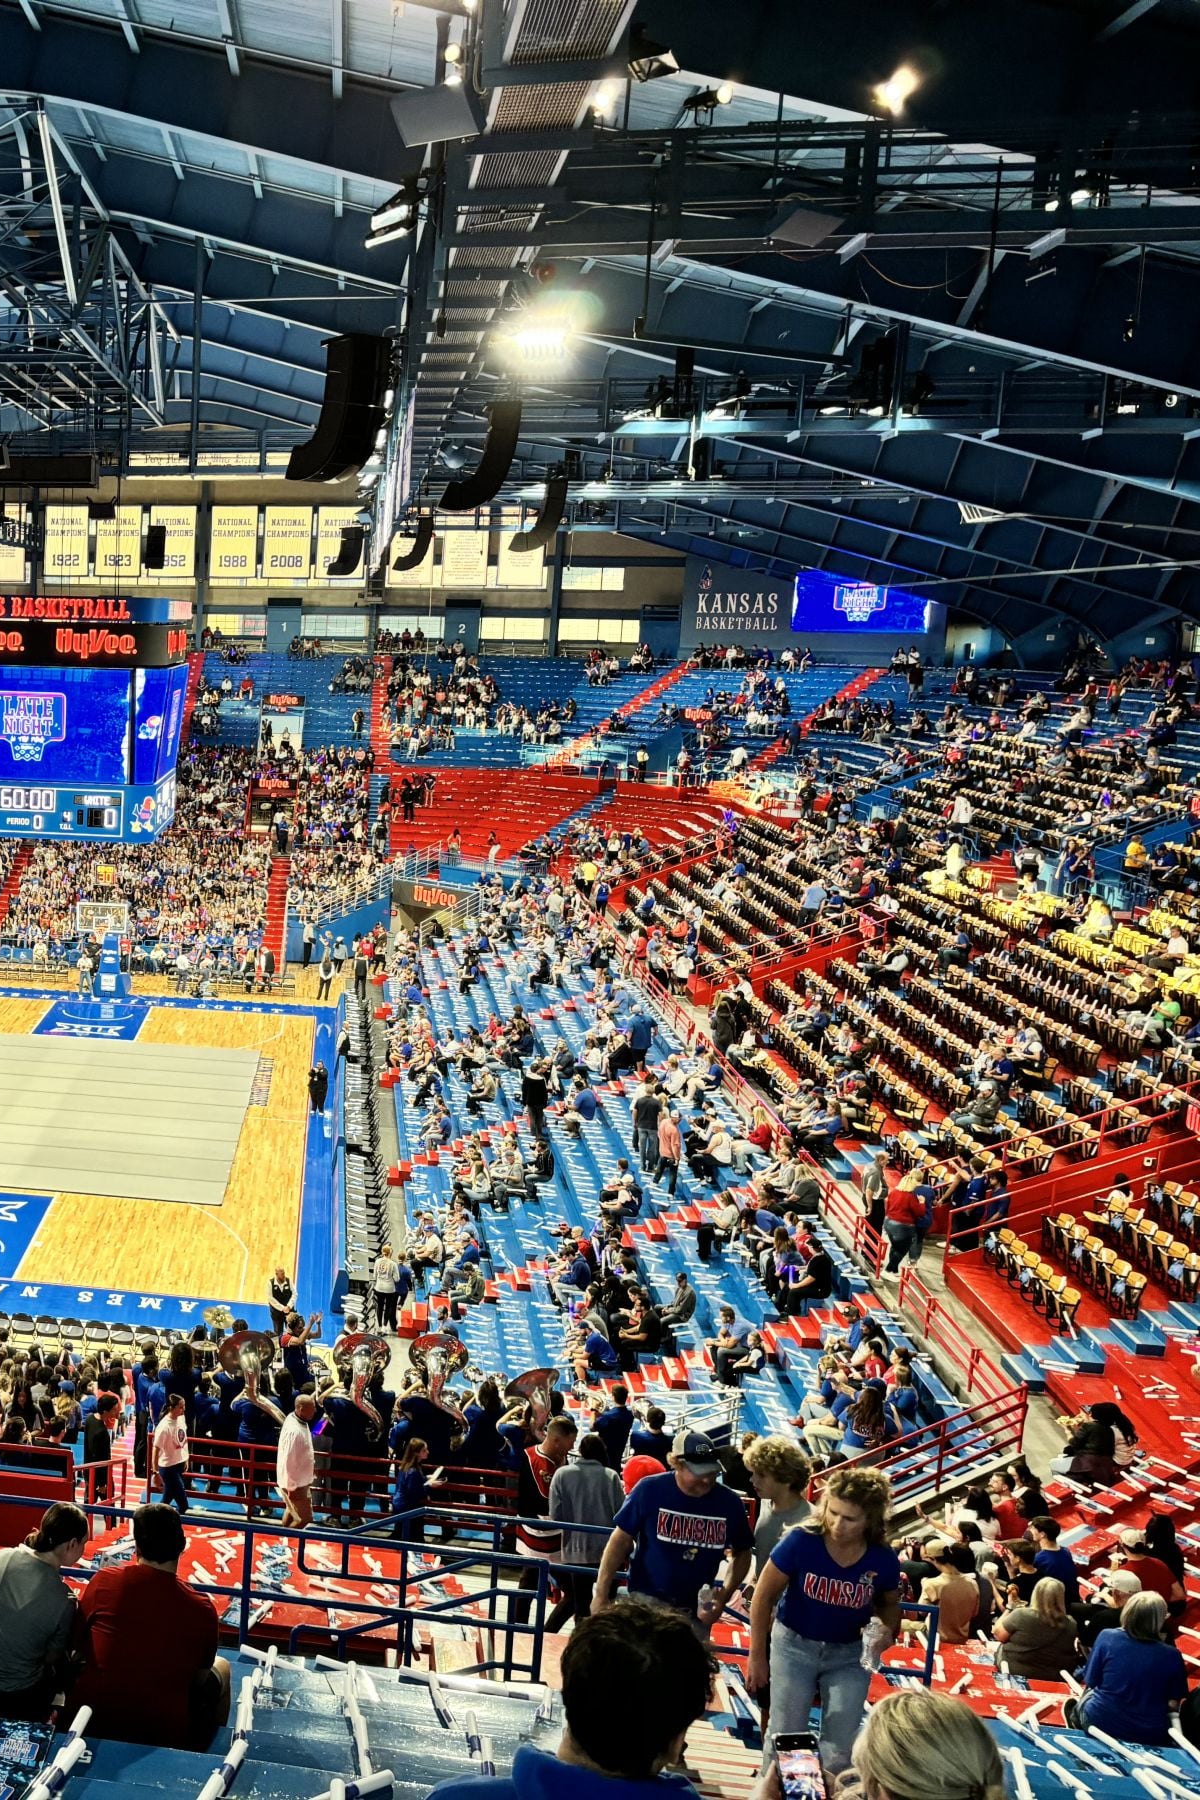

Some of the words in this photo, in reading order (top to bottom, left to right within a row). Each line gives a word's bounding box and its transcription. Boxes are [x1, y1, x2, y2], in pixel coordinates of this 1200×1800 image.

[51, 518, 83, 526] NATIONAL
[103, 518, 137, 526] NATIONAL
[156, 518, 191, 526] NATIONAL
[218, 518, 252, 526] NATIONAL
[271, 519, 306, 527] NATIONAL
[325, 519, 352, 527] NATION
[45, 529, 87, 537] CHAMPIONS
[98, 529, 140, 537] CHAMPIONS
[165, 529, 194, 537] MPIONS
[213, 530, 255, 538] CHAMPIONS
[266, 530, 309, 538] CHAMPIONS
[52, 555, 80, 567] 1922
[104, 555, 132, 567] 1923
[163, 555, 186, 567] 952
[219, 555, 247, 567] 1988
[271, 556, 303, 567] 2008
[696, 592, 779, 614] KANSAS
[10, 597, 131, 620] BASKETBALL
[281, 623, 287, 633] 1
[695, 616, 778, 631] BASKETBALL
[458, 624, 466, 634] 2
[3, 696, 54, 717] LATE
[3, 717, 54, 736] NIGHT
[0, 788, 54, 809] 60:00
[84, 795, 112, 805] WHITE
[6, 817, 30, 826] PERIOD
[33, 814, 43, 830] 0
[63, 812, 72, 822] 4
[104, 809, 116, 828] 0
[196, 1003, 285, 1013] COURT
[657, 1511, 727, 1545] KANSAS
[804, 1572, 874, 1609] KANSAS
